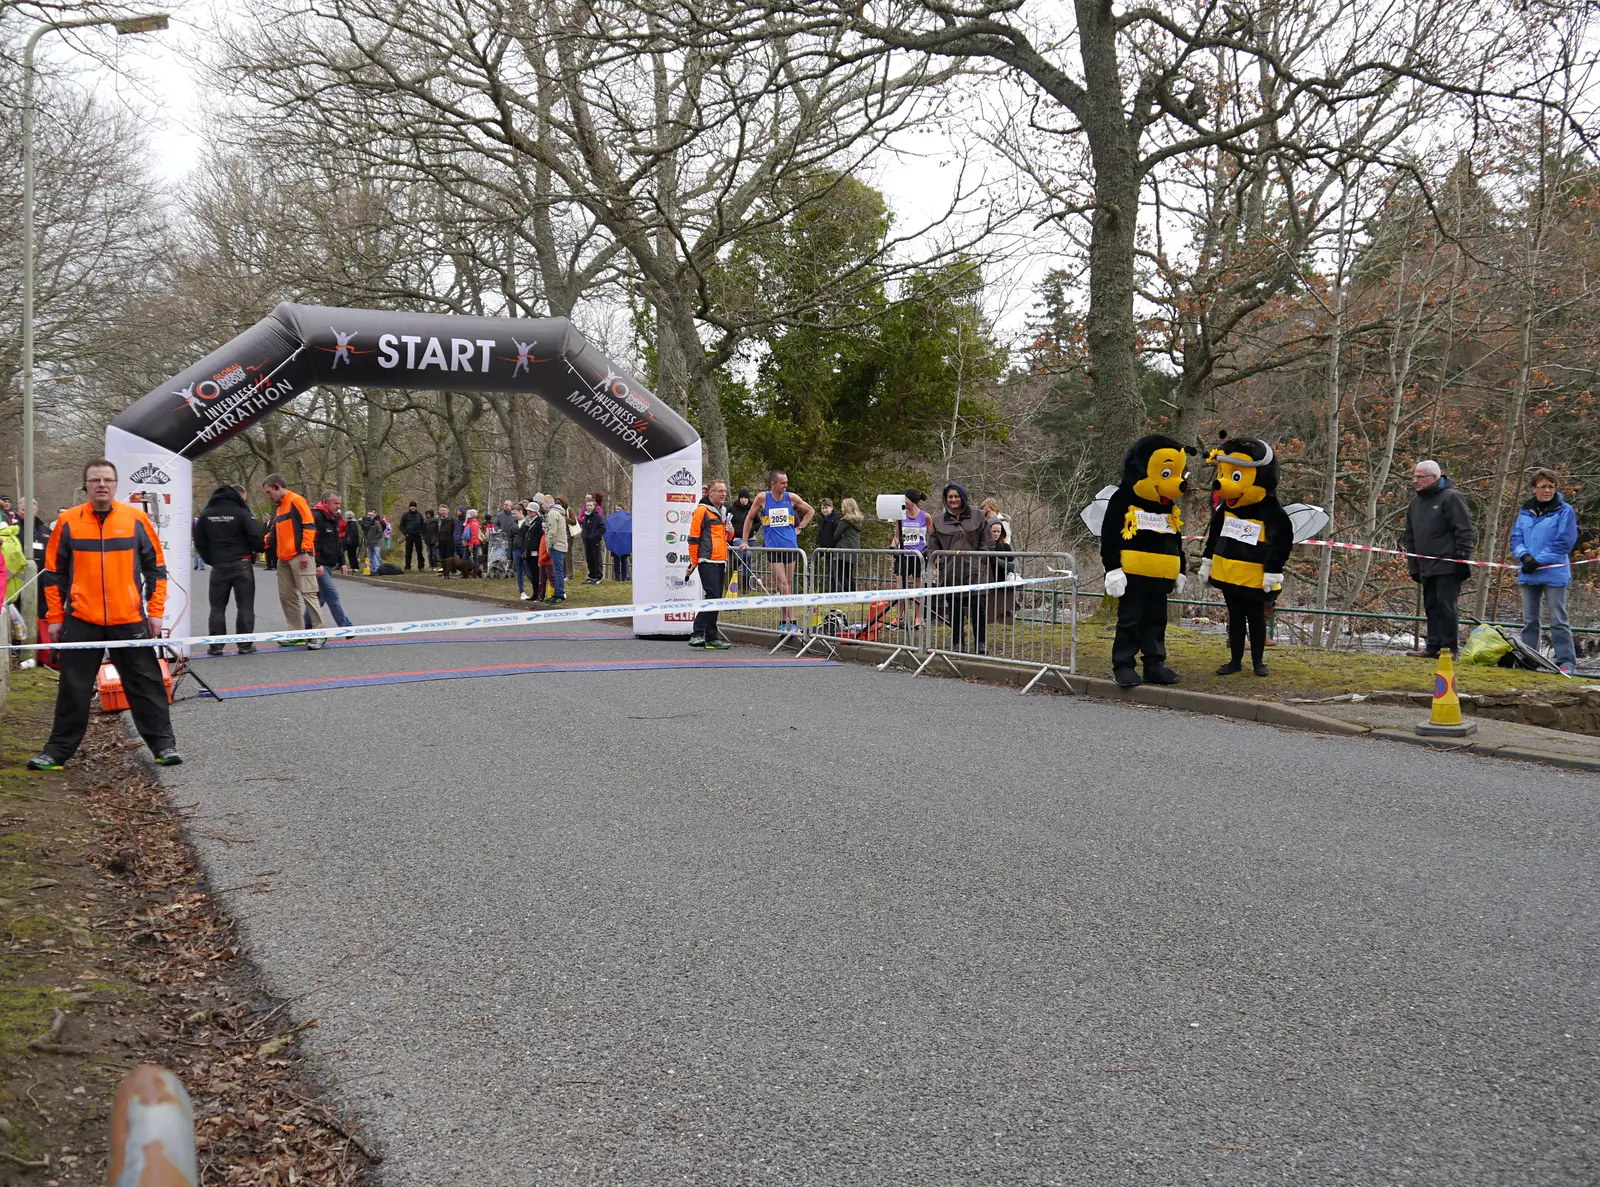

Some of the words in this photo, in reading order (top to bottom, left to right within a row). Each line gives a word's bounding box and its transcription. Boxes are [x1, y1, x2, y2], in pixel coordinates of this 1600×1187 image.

[377, 333, 496, 373] START
[213, 363, 241, 381] GLOBAL
[216, 367, 244, 387] ENERGY
[221, 373, 247, 390] GROUP
[196, 379, 293, 442] MARATHON
[204, 383, 258, 420] INVERNESS
[593, 391, 637, 425] INVERNESS
[566, 390, 648, 449] MARATHON
[131, 469, 169, 482] HIGHLAND
[771, 515, 787, 523] 2050
[139, 640, 183, 648] BROOKS
[354, 625, 393, 634] BROOKS
[420, 620, 458, 629] BROOKS
[483, 615, 519, 623] BROOKS
[602, 606, 636, 614] BROOKS
